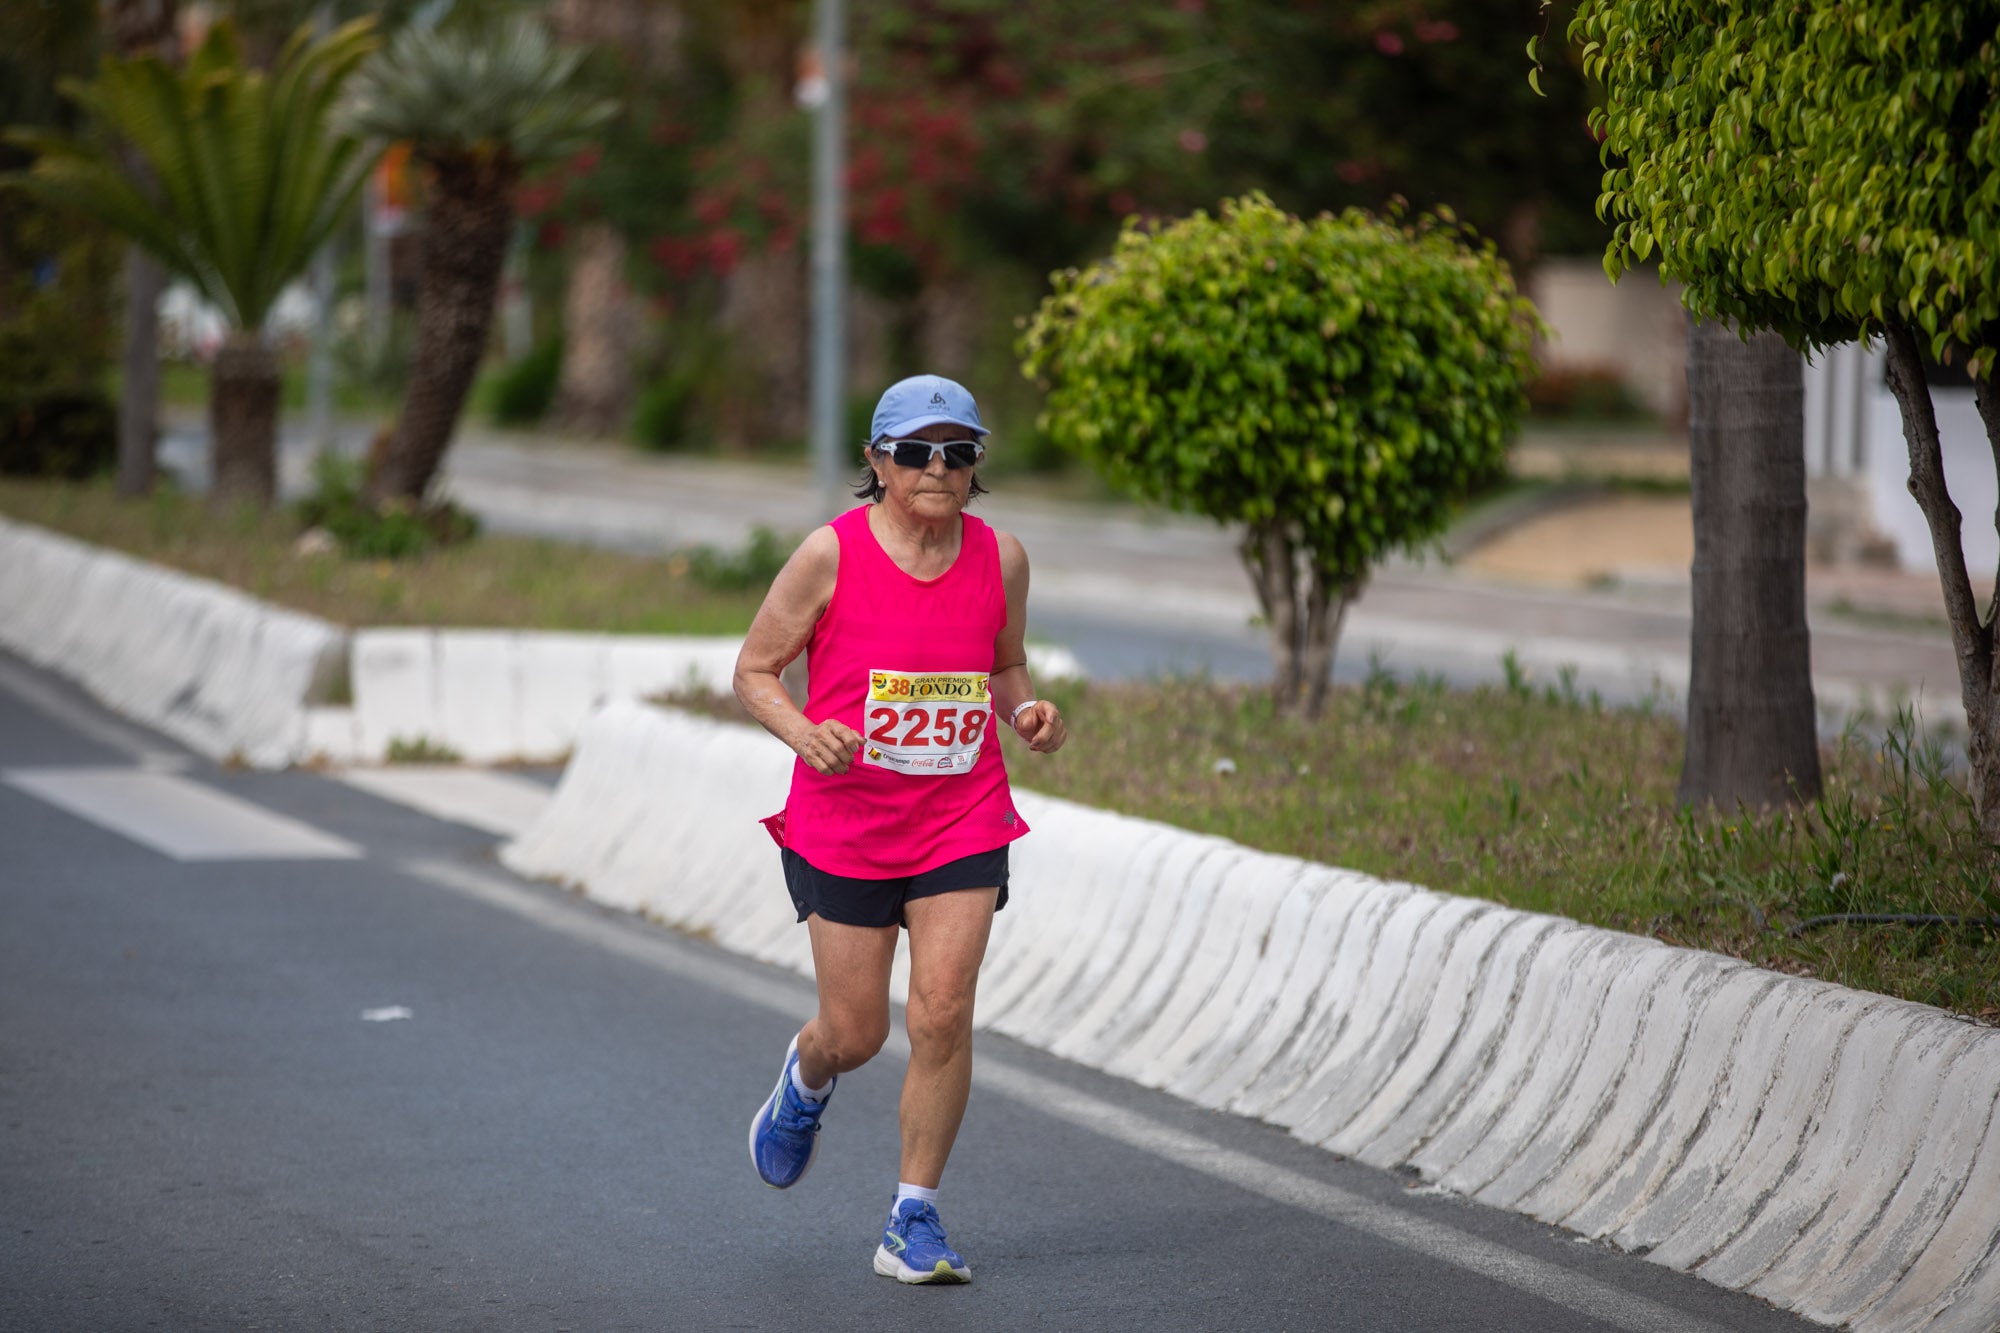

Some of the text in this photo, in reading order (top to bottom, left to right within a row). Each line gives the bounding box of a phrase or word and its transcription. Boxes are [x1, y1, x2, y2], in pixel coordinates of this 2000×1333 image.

[888, 678, 910, 695] 38
[910, 683, 972, 696] FONDO
[869, 707, 987, 747] 2258
